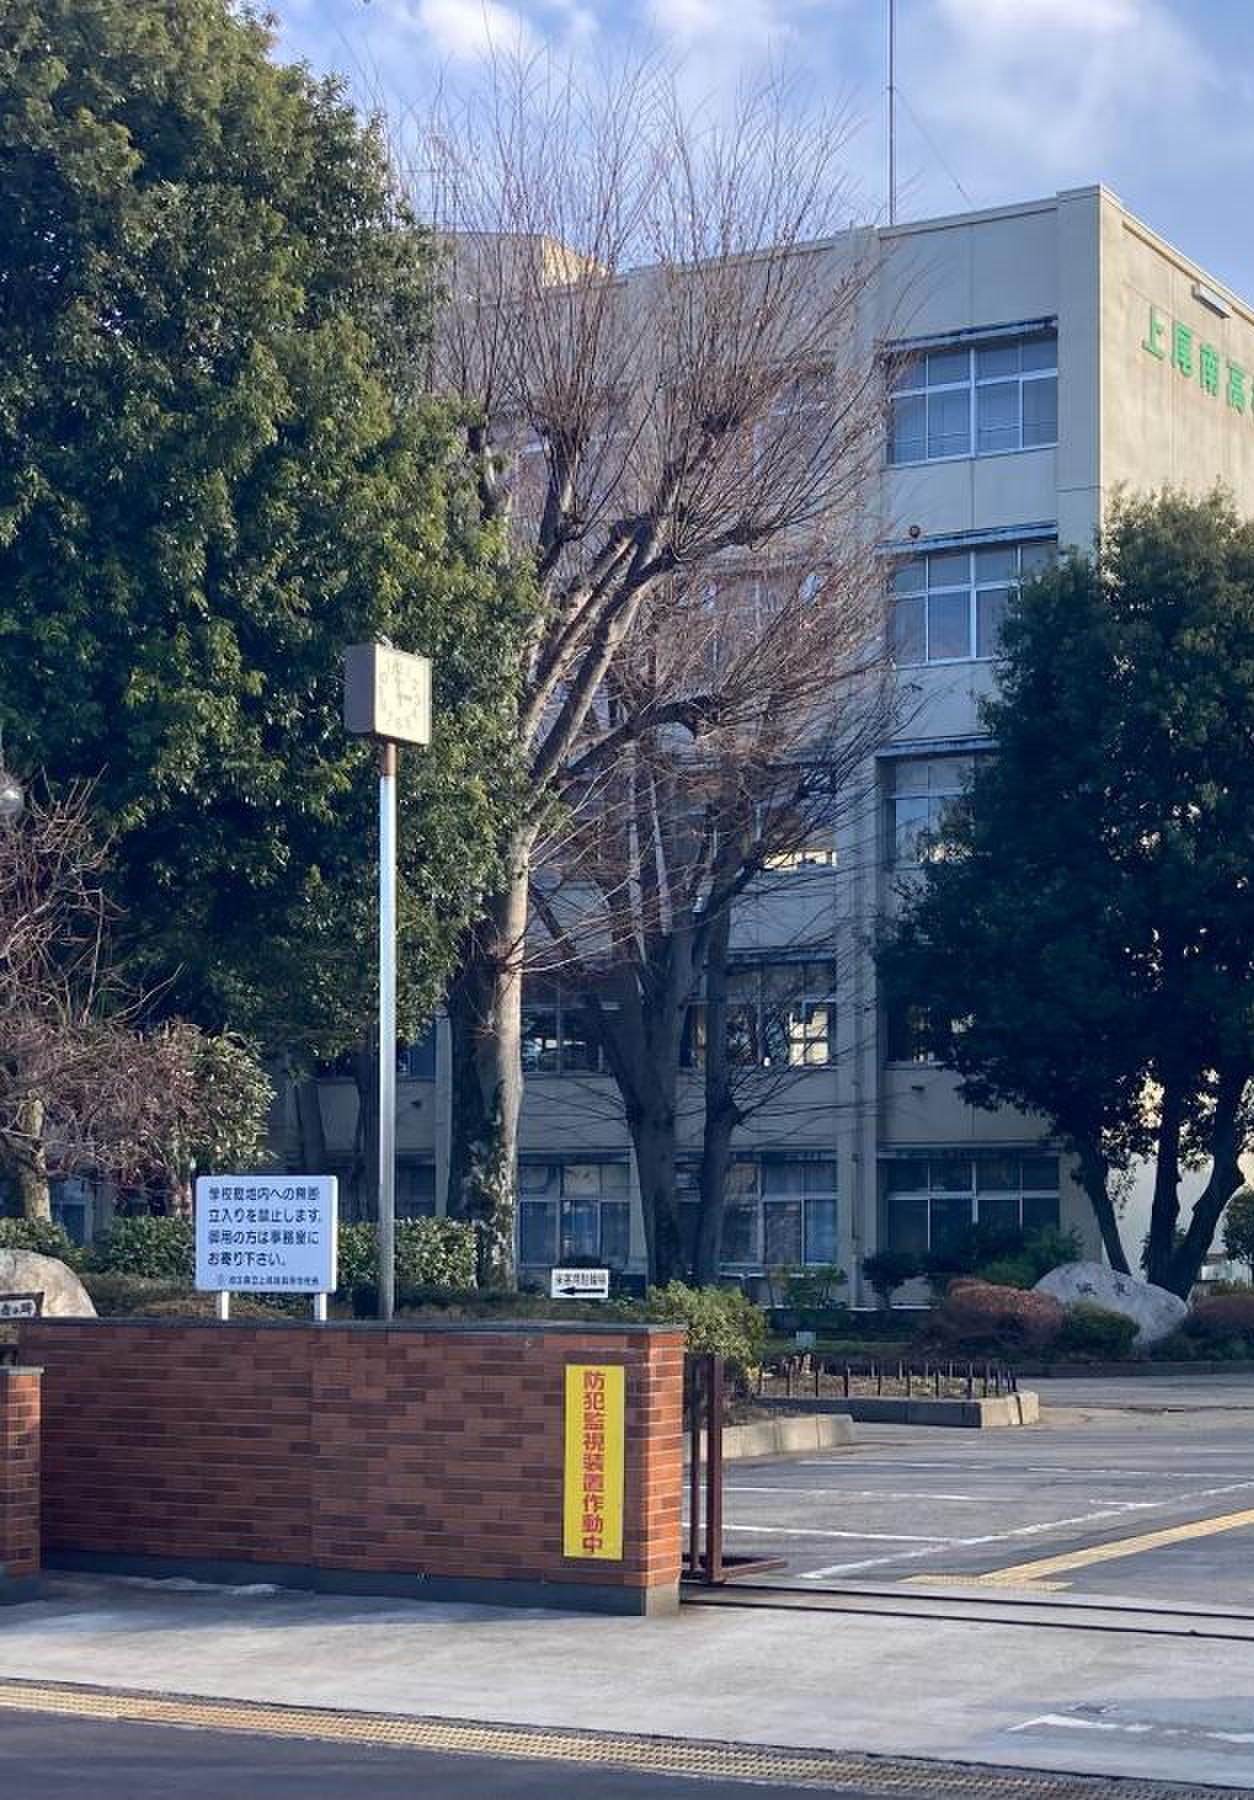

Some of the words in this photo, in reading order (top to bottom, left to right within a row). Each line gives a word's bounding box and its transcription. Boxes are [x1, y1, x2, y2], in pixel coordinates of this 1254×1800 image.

[208, 1187, 320, 1200] 学校敷地内への無断
[208, 1230, 320, 1245] 御用の方は事務室に
[208, 1251, 286, 1266] お寄り下さい。
[582, 1371, 605, 1553] 防犯監視装置作動中
